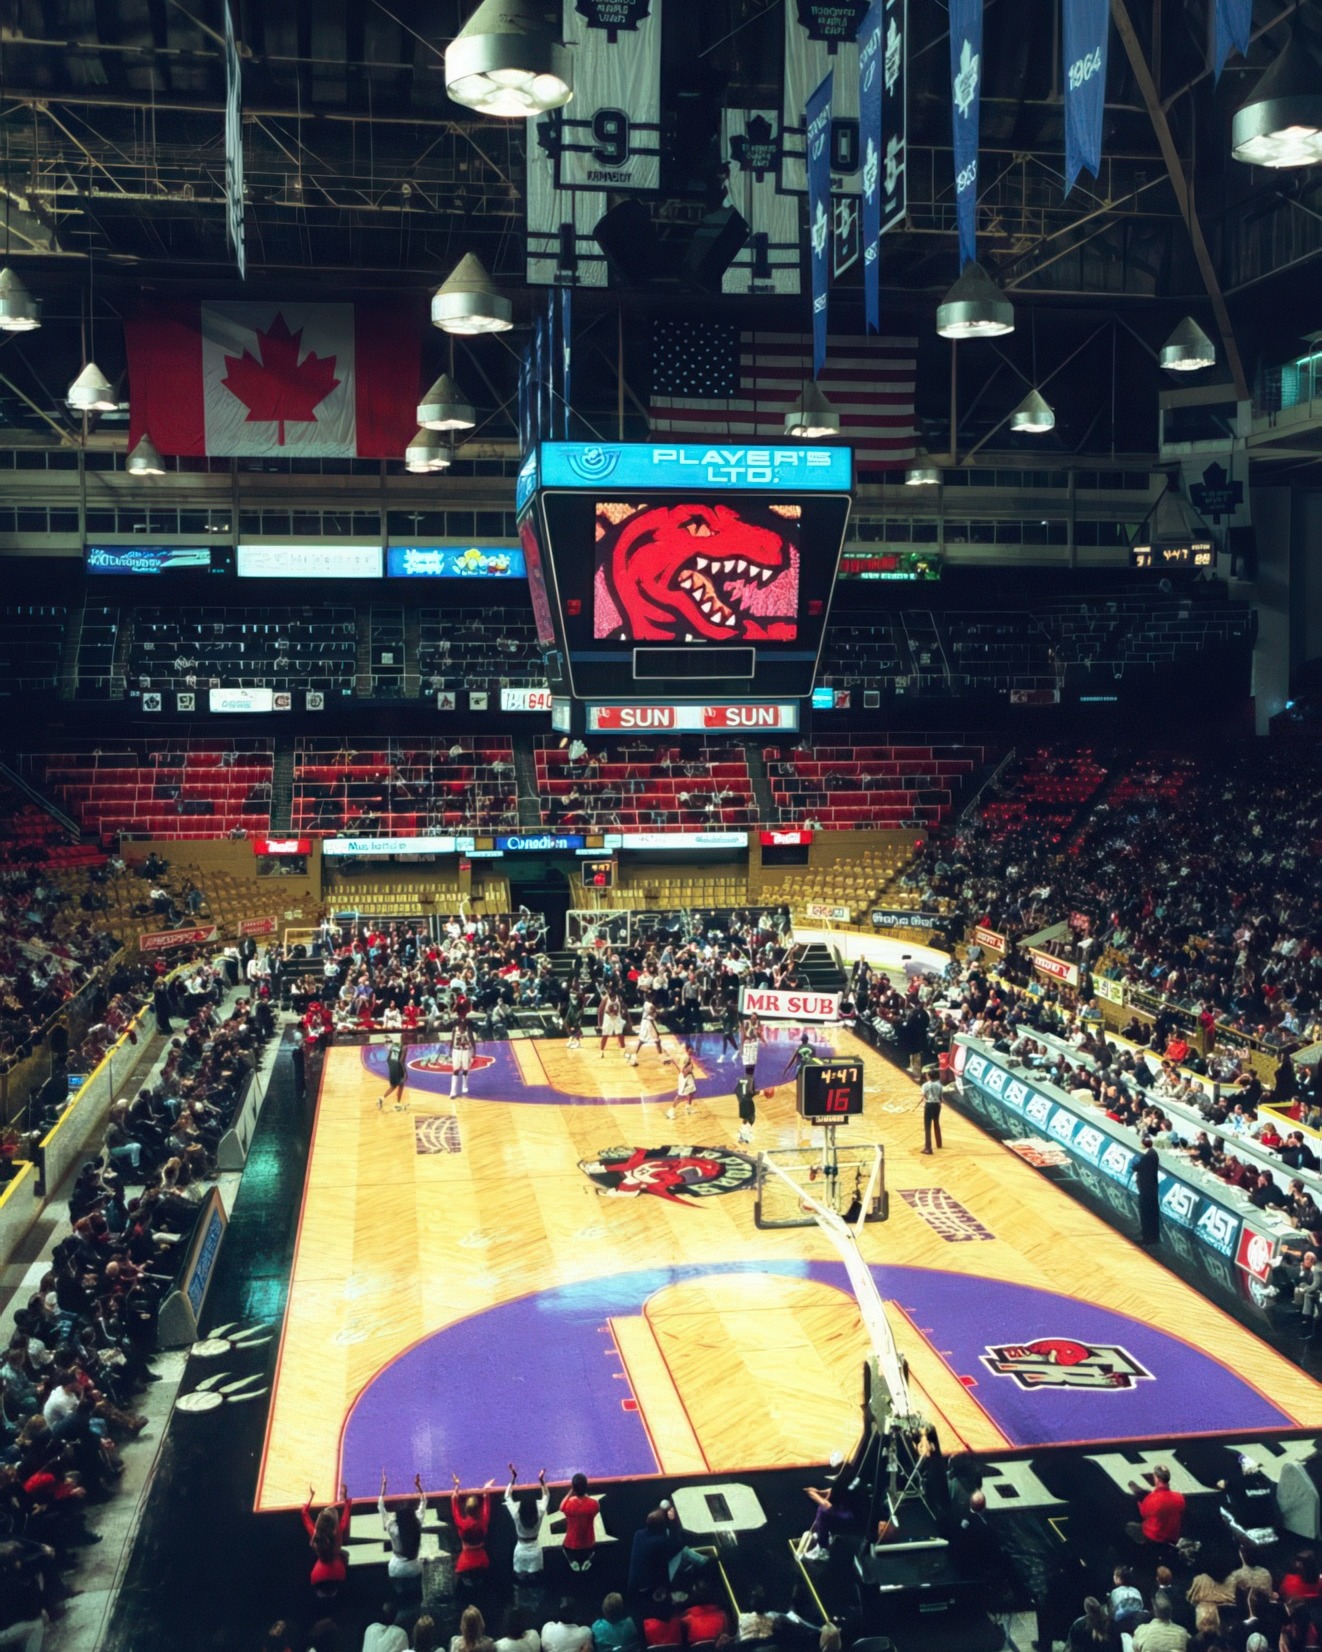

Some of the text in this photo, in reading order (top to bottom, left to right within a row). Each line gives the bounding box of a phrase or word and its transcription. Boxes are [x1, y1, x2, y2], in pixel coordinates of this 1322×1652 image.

[591, 107, 630, 168] 9
[653, 449, 832, 466] PLAYER'S
[620, 708, 670, 727] SUN
[725, 707, 774, 726] SUN
[746, 993, 834, 1014] MR SUB
[821, 1068, 858, 1084] 4:47
[739, 1079, 748, 1095] 7
[826, 1088, 851, 1112] 16
[1162, 1182, 1199, 1218] AST
[1197, 1205, 1239, 1246] AST
